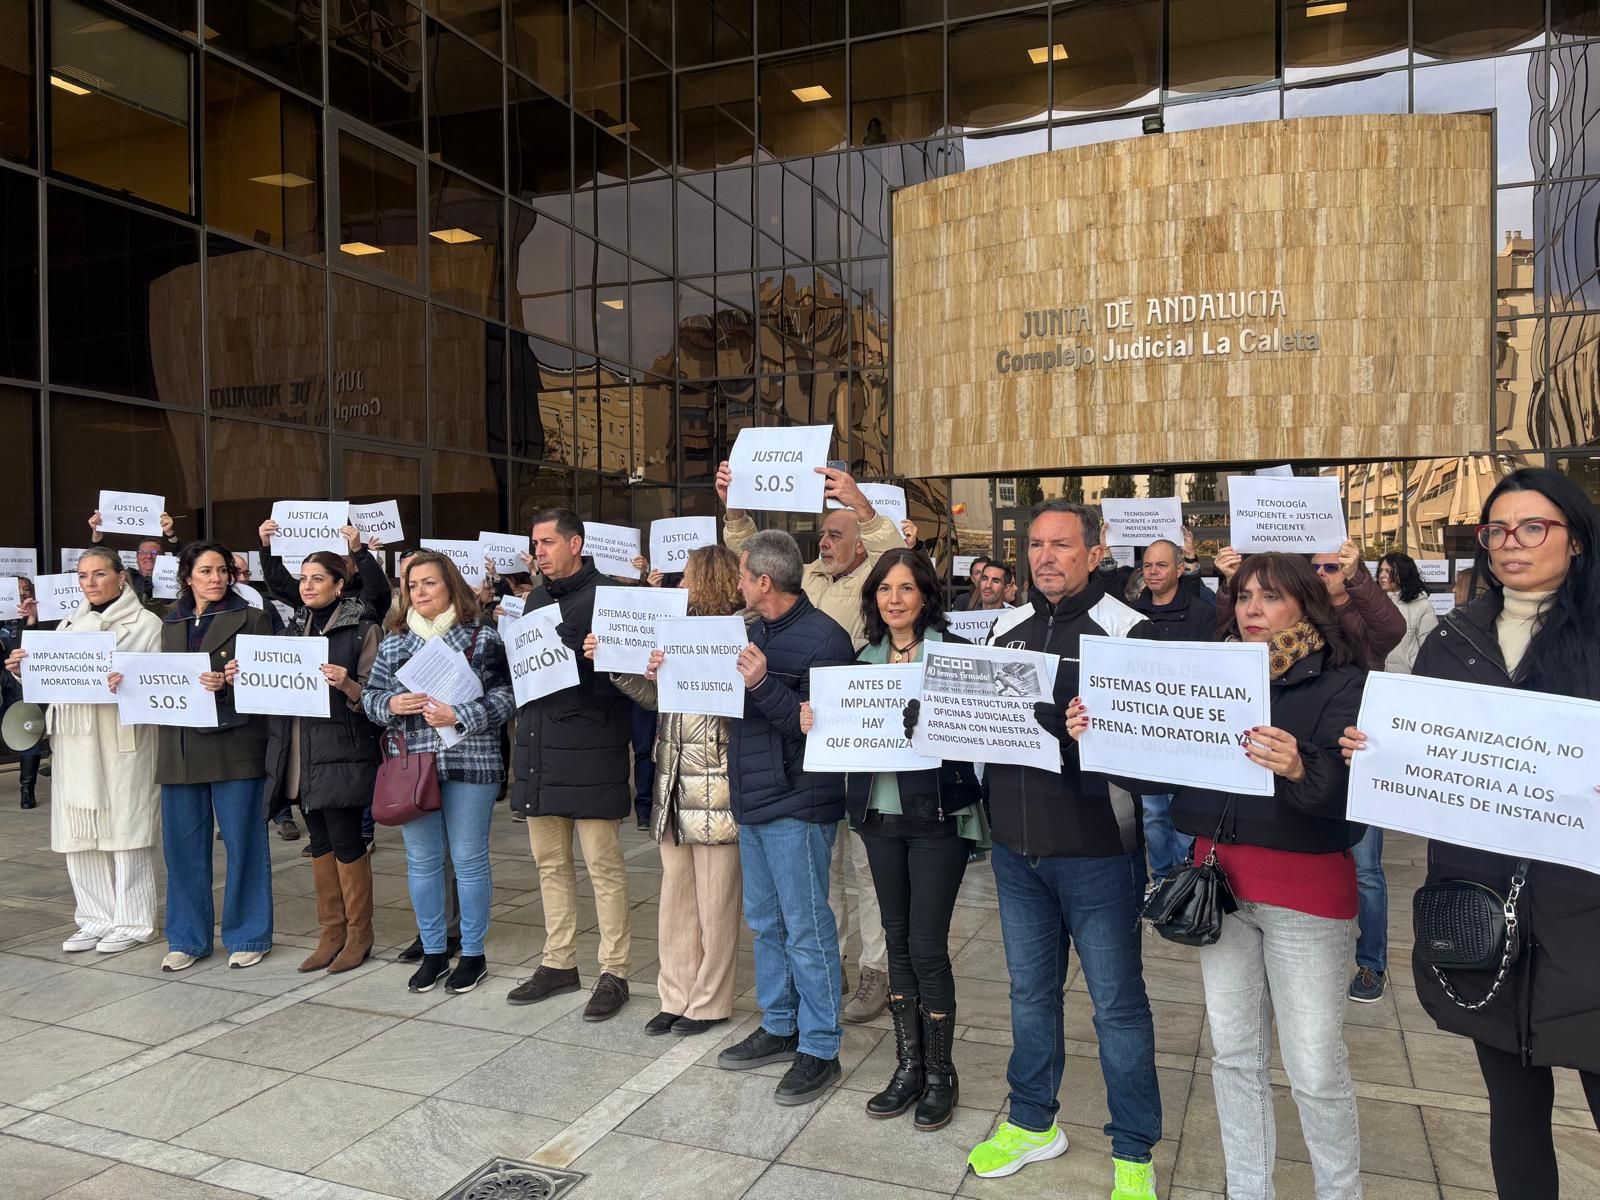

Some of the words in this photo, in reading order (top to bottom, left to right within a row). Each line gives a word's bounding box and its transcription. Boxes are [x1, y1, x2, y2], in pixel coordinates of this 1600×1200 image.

[1019, 307, 1092, 338] JUNTA
[1105, 301, 1133, 329] DE
[1146, 290, 1286, 324] ANDALUCIA
[996, 343, 1094, 373] Complejo
[1102, 333, 1193, 362] Judicial
[1202, 331, 1230, 356] La
[1239, 328, 1319, 352] Caleta
[752, 451, 803, 462] JUSTICIA
[754, 474, 794, 492] S.O.S
[113, 505, 148, 513] JUSTICIA
[1257, 499, 1307, 508] TECNOLOGÍA
[287, 512, 328, 520] JUSTICIA
[1237, 510, 1287, 519] INSUFICIENTE
[117, 516, 144, 526] S.O.S
[276, 525, 340, 539] SOLUCIÓN
[663, 532, 699, 543] JUSTICIA
[492, 558, 513, 566] S.O.S
[596, 552, 628, 563] MORATORIA
[667, 550, 688, 562] S.O.
[54, 587, 84, 595] JUSTIC
[60, 600, 80, 609] S.O
[598, 608, 630, 620] SISTEMAS
[632, 612, 646, 621] QUE
[609, 623, 638, 632] JUSTICIA
[639, 625, 655, 634] QUE
[515, 628, 542, 650] JUSTICIA
[598, 635, 622, 646] FRENA:
[625, 638, 657, 648] MORATO
[663, 644, 694, 654] JUSTICIA
[696, 645, 708, 654] SIN
[711, 646, 742, 654] MEDIOS
[33, 651, 94, 660] IMPLANTACIÓN
[97, 652, 106, 661] SÍ,
[253, 651, 301, 664] JUSTICIA
[513, 645, 569, 679] SOLUCIÓN
[29, 663, 94, 672] IMPROVISACIÓN
[934, 657, 972, 670] CCOO
[41, 678, 89, 686] MORATORIA
[139, 674, 189, 685] JUSTICIA
[240, 671, 317, 690] SOLUCIÓN
[959, 672, 990, 681] firmado!
[677, 682, 689, 690] NO
[691, 682, 699, 690] ES
[701, 682, 733, 692] JUSTICIA
[848, 680, 882, 690] ANTES
[884, 680, 901, 690] DE
[1090, 675, 1151, 693] SISTEMAS
[1156, 682, 1186, 696] QUE
[1191, 685, 1251, 703] FALLAN,
[149, 695, 187, 710] S.O.S
[841, 698, 907, 708] IMPLANTAR
[934, 696, 960, 705] NUEVA
[962, 698, 1019, 709] ESTRUCTURA
[934, 708, 972, 718] OFICINAS
[974, 711, 1025, 722] JUDICIALES
[1111, 700, 1168, 717] JUSTICIA
[1173, 706, 1203, 720] QUE
[1209, 709, 1225, 722] SE
[862, 718, 884, 728] HAY
[928, 720, 967, 731] ARRASAN
[969, 724, 987, 732] CON
[990, 726, 1039, 735] NUESTRAS
[1092, 718, 1137, 735] FRENA:
[1142, 724, 1230, 745] MORATORIA
[1392, 717, 1416, 732] SIN
[1421, 723, 1551, 755] ORGANIZACIÓN,
[1557, 744, 1584, 758] NO
[826, 737, 850, 749] QUE
[854, 738, 913, 749] ORGANIZA
[928, 734, 984, 745] CONDICIONES
[987, 739, 1040, 749] LABORALES
[1427, 745, 1458, 760] HAY
[1461, 751, 1537, 774] JUSTICIA:
[1405, 764, 1501, 792] MORATORIA
[1507, 784, 1518, 795] A
[1524, 786, 1554, 802] LOS
[1372, 778, 1464, 807] TRIBUNALES
[1470, 797, 1490, 812] DE
[1495, 802, 1584, 829] INSTANCIA
